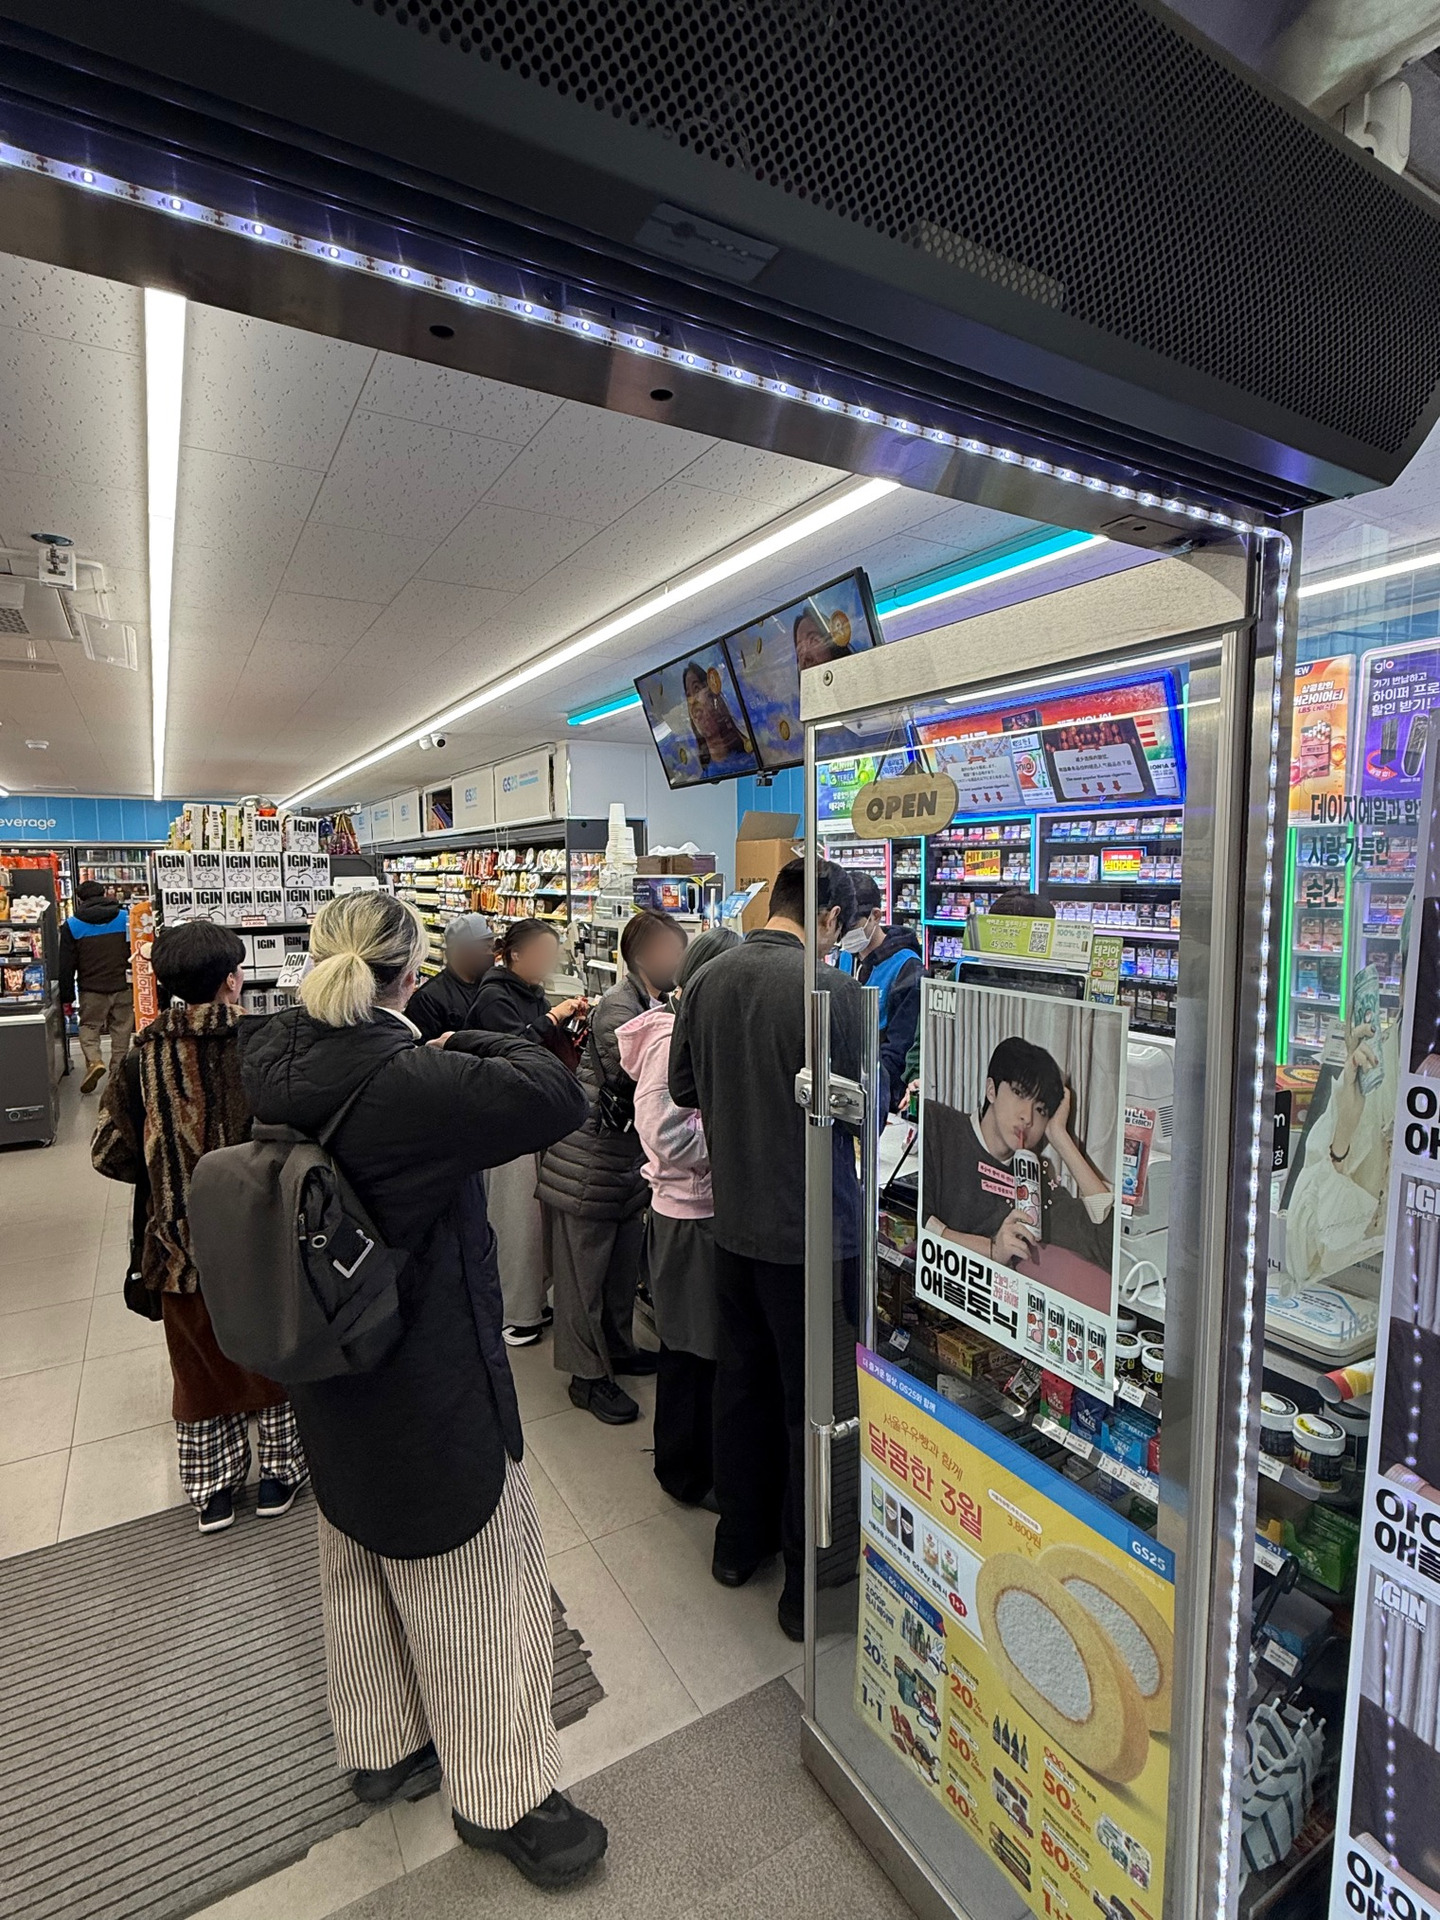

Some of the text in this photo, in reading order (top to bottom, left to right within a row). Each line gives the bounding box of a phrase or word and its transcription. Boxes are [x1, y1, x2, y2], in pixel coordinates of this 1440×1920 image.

[1374, 659, 1394, 673] glo
[1374, 672, 1427, 688] 기기 반납하고
[1373, 686, 1409, 702] 하이퍼
[1372, 697, 1431, 718] 할인 받기!
[866, 790, 938, 822] OPEN
[1310, 794, 1421, 826] 데이지에일과 함
[255, 819, 280, 833] IGIN
[293, 818, 317, 833] IGIN
[158, 855, 185, 868] IGIN
[193, 854, 220, 868] IGIN
[226, 855, 251, 868] IGIN
[254, 855, 279, 868] IGIN
[287, 854, 311, 867] IGIN
[1307, 837, 1390, 866] 사랑 가득한
[165, 892, 193, 905] IGIN
[196, 891, 223, 904] IGIN
[226, 891, 252, 904] IGIN
[256, 890, 282, 903] IGIN
[286, 890, 310, 902] IGIN
[1306, 878, 1340, 908] 순간
[1057, 928, 1075, 937] 100%
[257, 939, 276, 949] IGIN
[1094, 945, 1120, 958] 테리아
[285, 954, 308, 967] IGIN
[928, 988, 957, 1014] IGIN
[1015, 1158, 1040, 1183] IGIN
[1405, 1208, 1436, 1222] APPLE
[920, 1265, 1018, 1341] 애플토닉
[1027, 1292, 1045, 1313] IGIN
[1048, 1308, 1065, 1327] IGIN
[1067, 1317, 1084, 1339] IGIN
[1340, 1309, 1377, 1343] Lifes
[1088, 1328, 1106, 1349] IGIN
[899, 1381, 923, 1405] GS25와
[923, 1398, 937, 1414] 함께
[1077, 1411, 1096, 1430] HALLS
[883, 1413, 963, 1482] 서울우유빵과 함께
[1137, 1465, 1149, 1477] 2+1
[868, 1421, 934, 1501] 달콤한
[940, 1478, 983, 1543] 3월
[1007, 1514, 1042, 1550] 3,800원
[1131, 1540, 1166, 1571] GS25
[1266, 1542, 1281, 1555] 2+1
[949, 1595, 966, 1615] 1+1
[1373, 1573, 1428, 1626] IGIN
[1373, 1599, 1427, 1634] APPLE TONIC
[862, 1633, 889, 1670] 20%
[861, 1683, 883, 1723] 1+1
[950, 1673, 983, 1714] 20%
[947, 1725, 980, 1768] 50%
[1042, 1768, 1083, 1818] 50%
[945, 1784, 979, 1825] 40%
[1040, 1830, 1081, 1879] 80%
